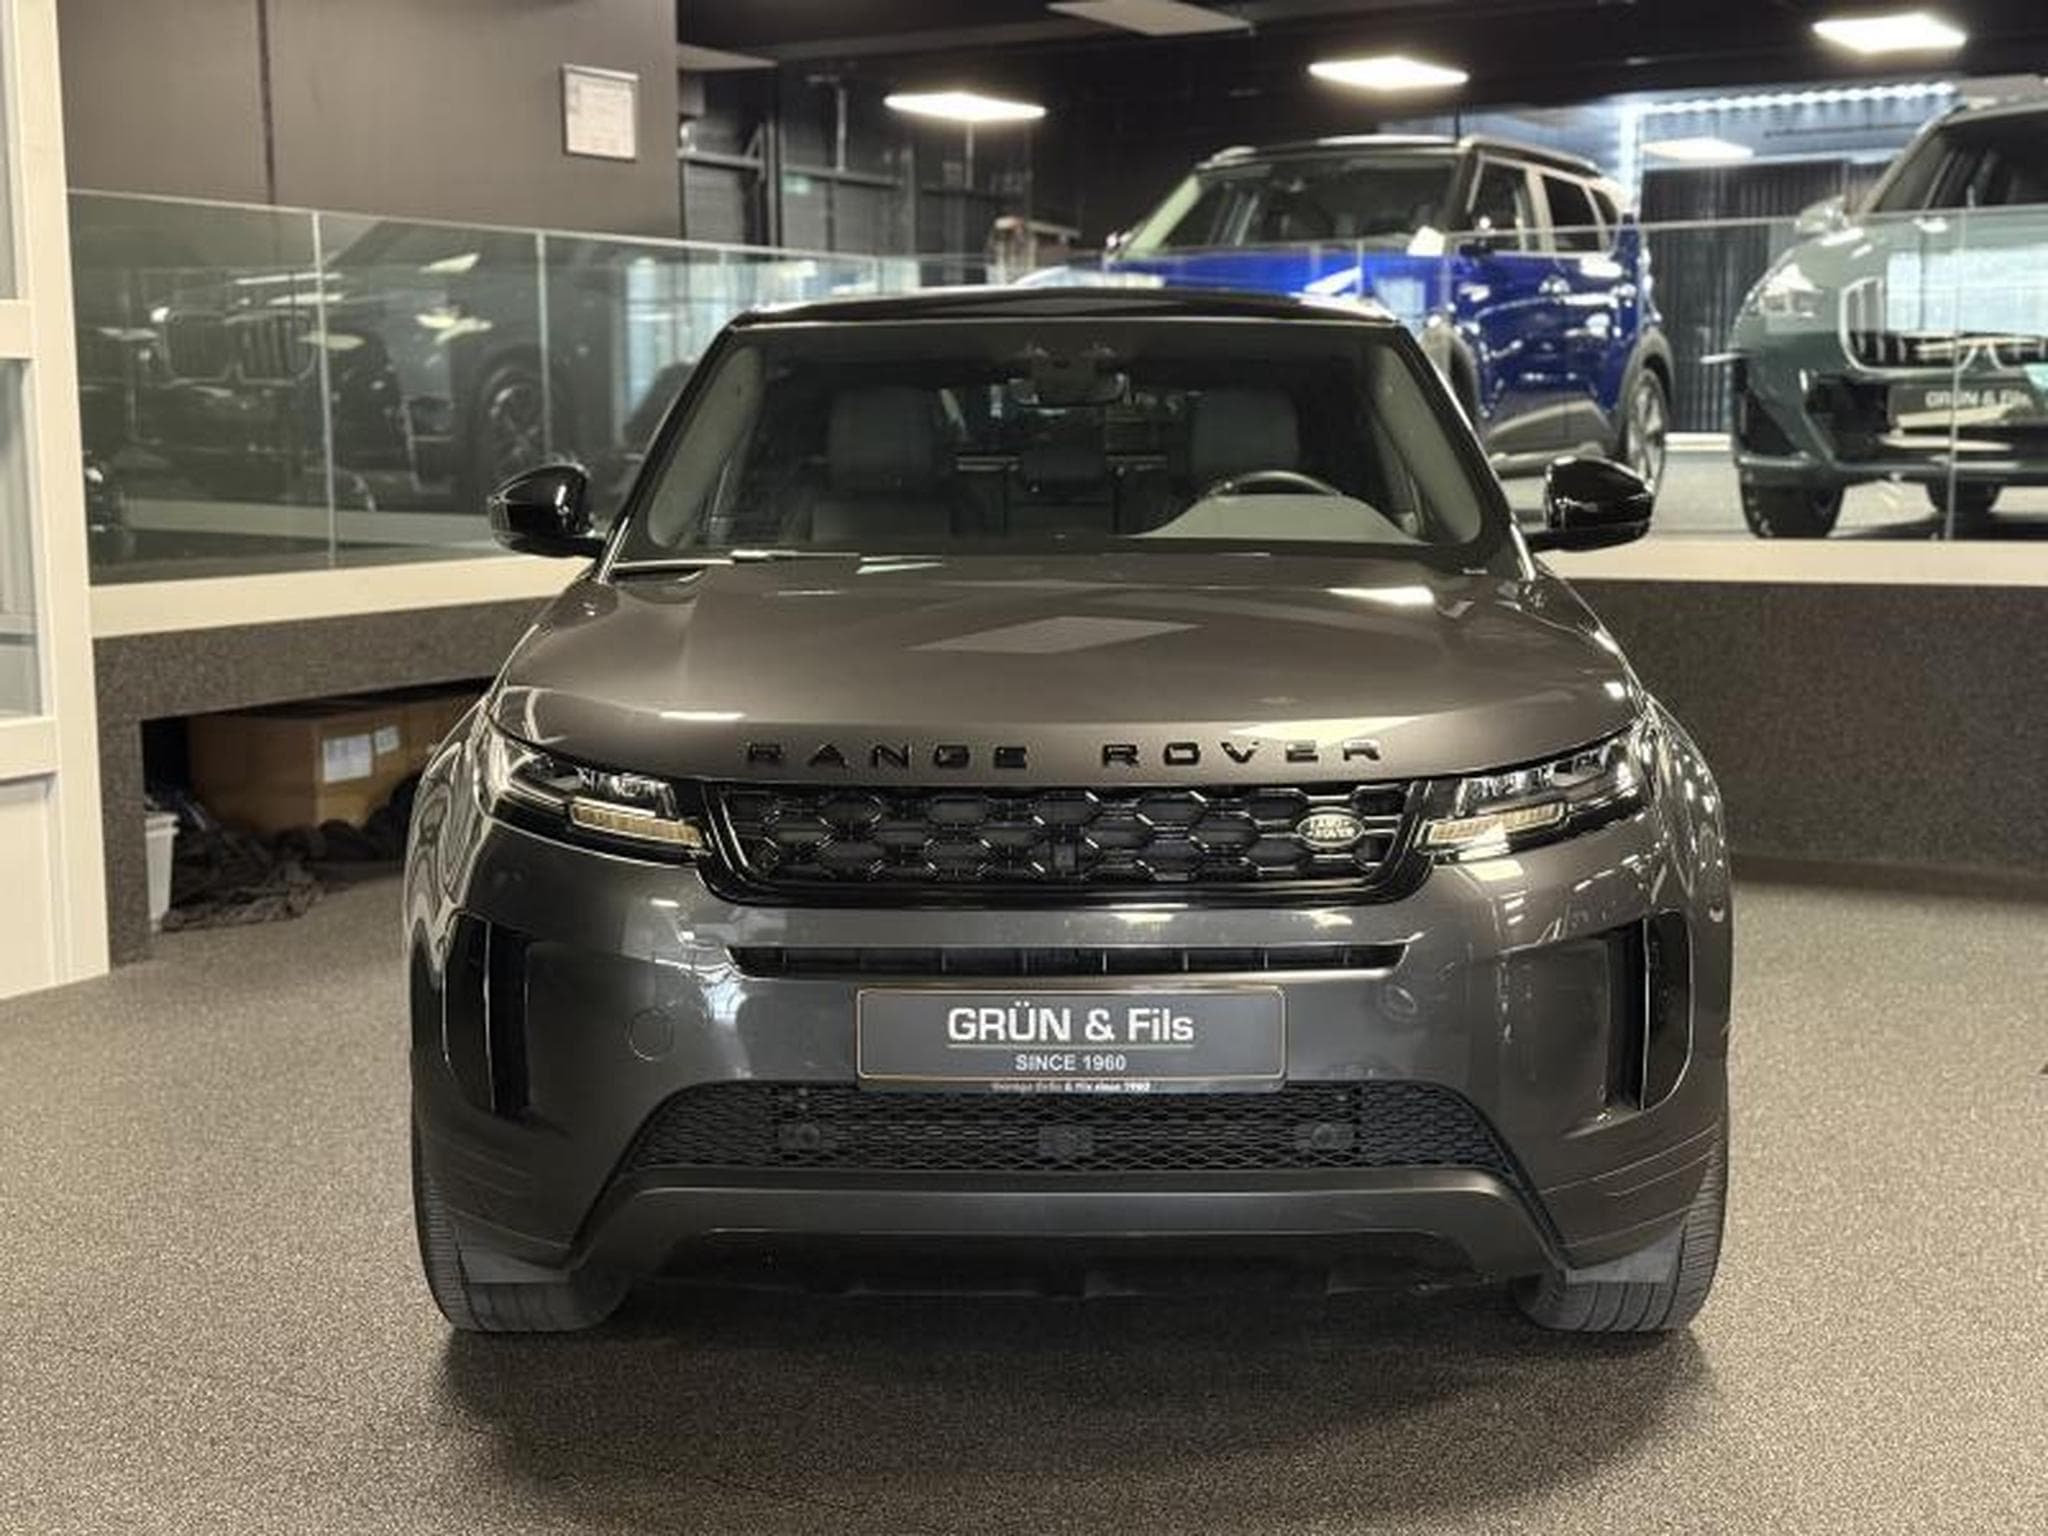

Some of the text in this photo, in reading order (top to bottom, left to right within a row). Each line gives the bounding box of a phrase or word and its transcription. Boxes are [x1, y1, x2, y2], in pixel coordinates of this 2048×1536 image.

[748, 739, 1381, 769] RANGE ROVER
[947, 1001, 1195, 1041] GRÜN & Fils
[1015, 1055, 1127, 1072] SINCE 1960
